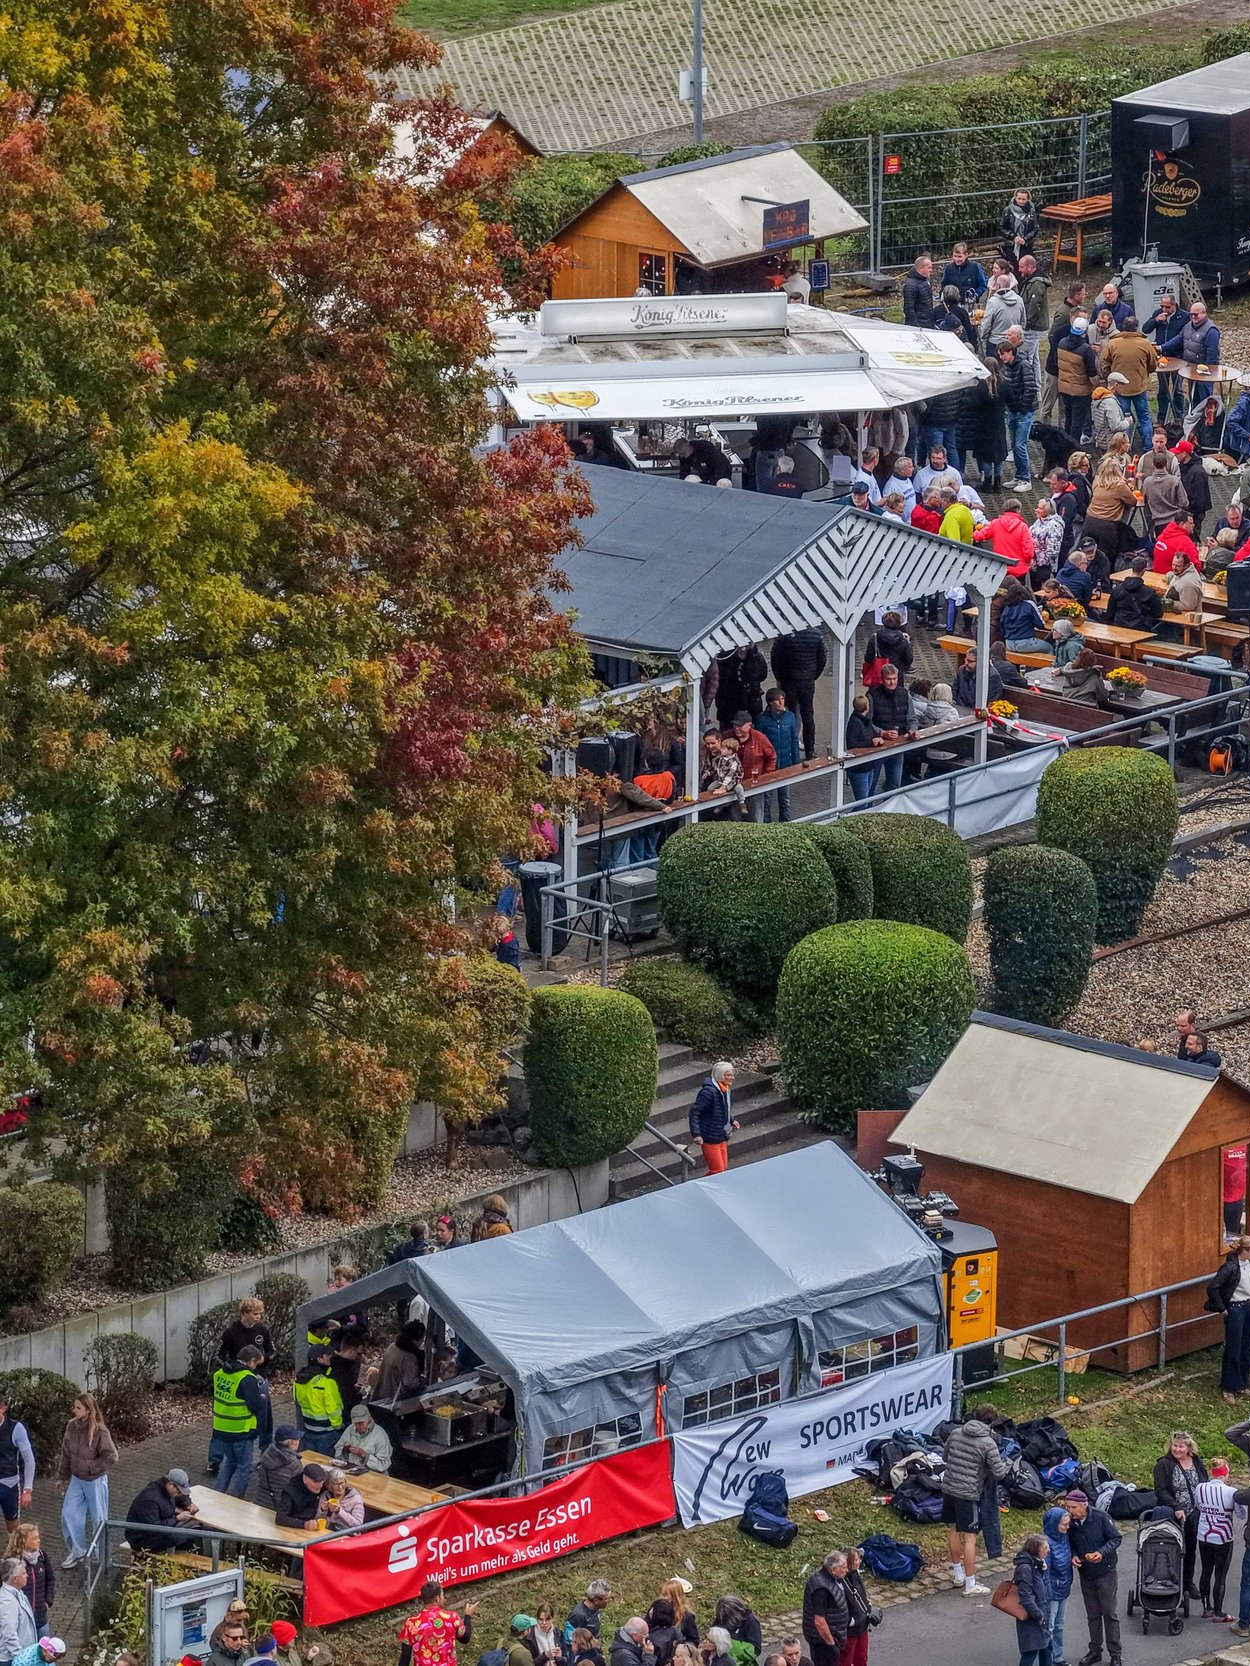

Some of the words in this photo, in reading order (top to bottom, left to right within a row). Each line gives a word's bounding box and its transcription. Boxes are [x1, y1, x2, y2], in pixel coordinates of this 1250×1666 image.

[1141, 171, 1200, 206] Radeberger
[662, 398, 725, 409] König
[723, 394, 806, 406] Pilsener
[800, 1384, 943, 1450] SPORTSWEAR
[427, 1518, 531, 1564] Sparkasse
[534, 1496, 593, 1532] Essen
[427, 1566, 458, 1584] Weil's
[460, 1562, 479, 1577] um
[481, 1555, 510, 1572] mehr
[512, 1546, 526, 1563] als
[526, 1539, 551, 1560] Geld
[553, 1531, 580, 1554] geht.
